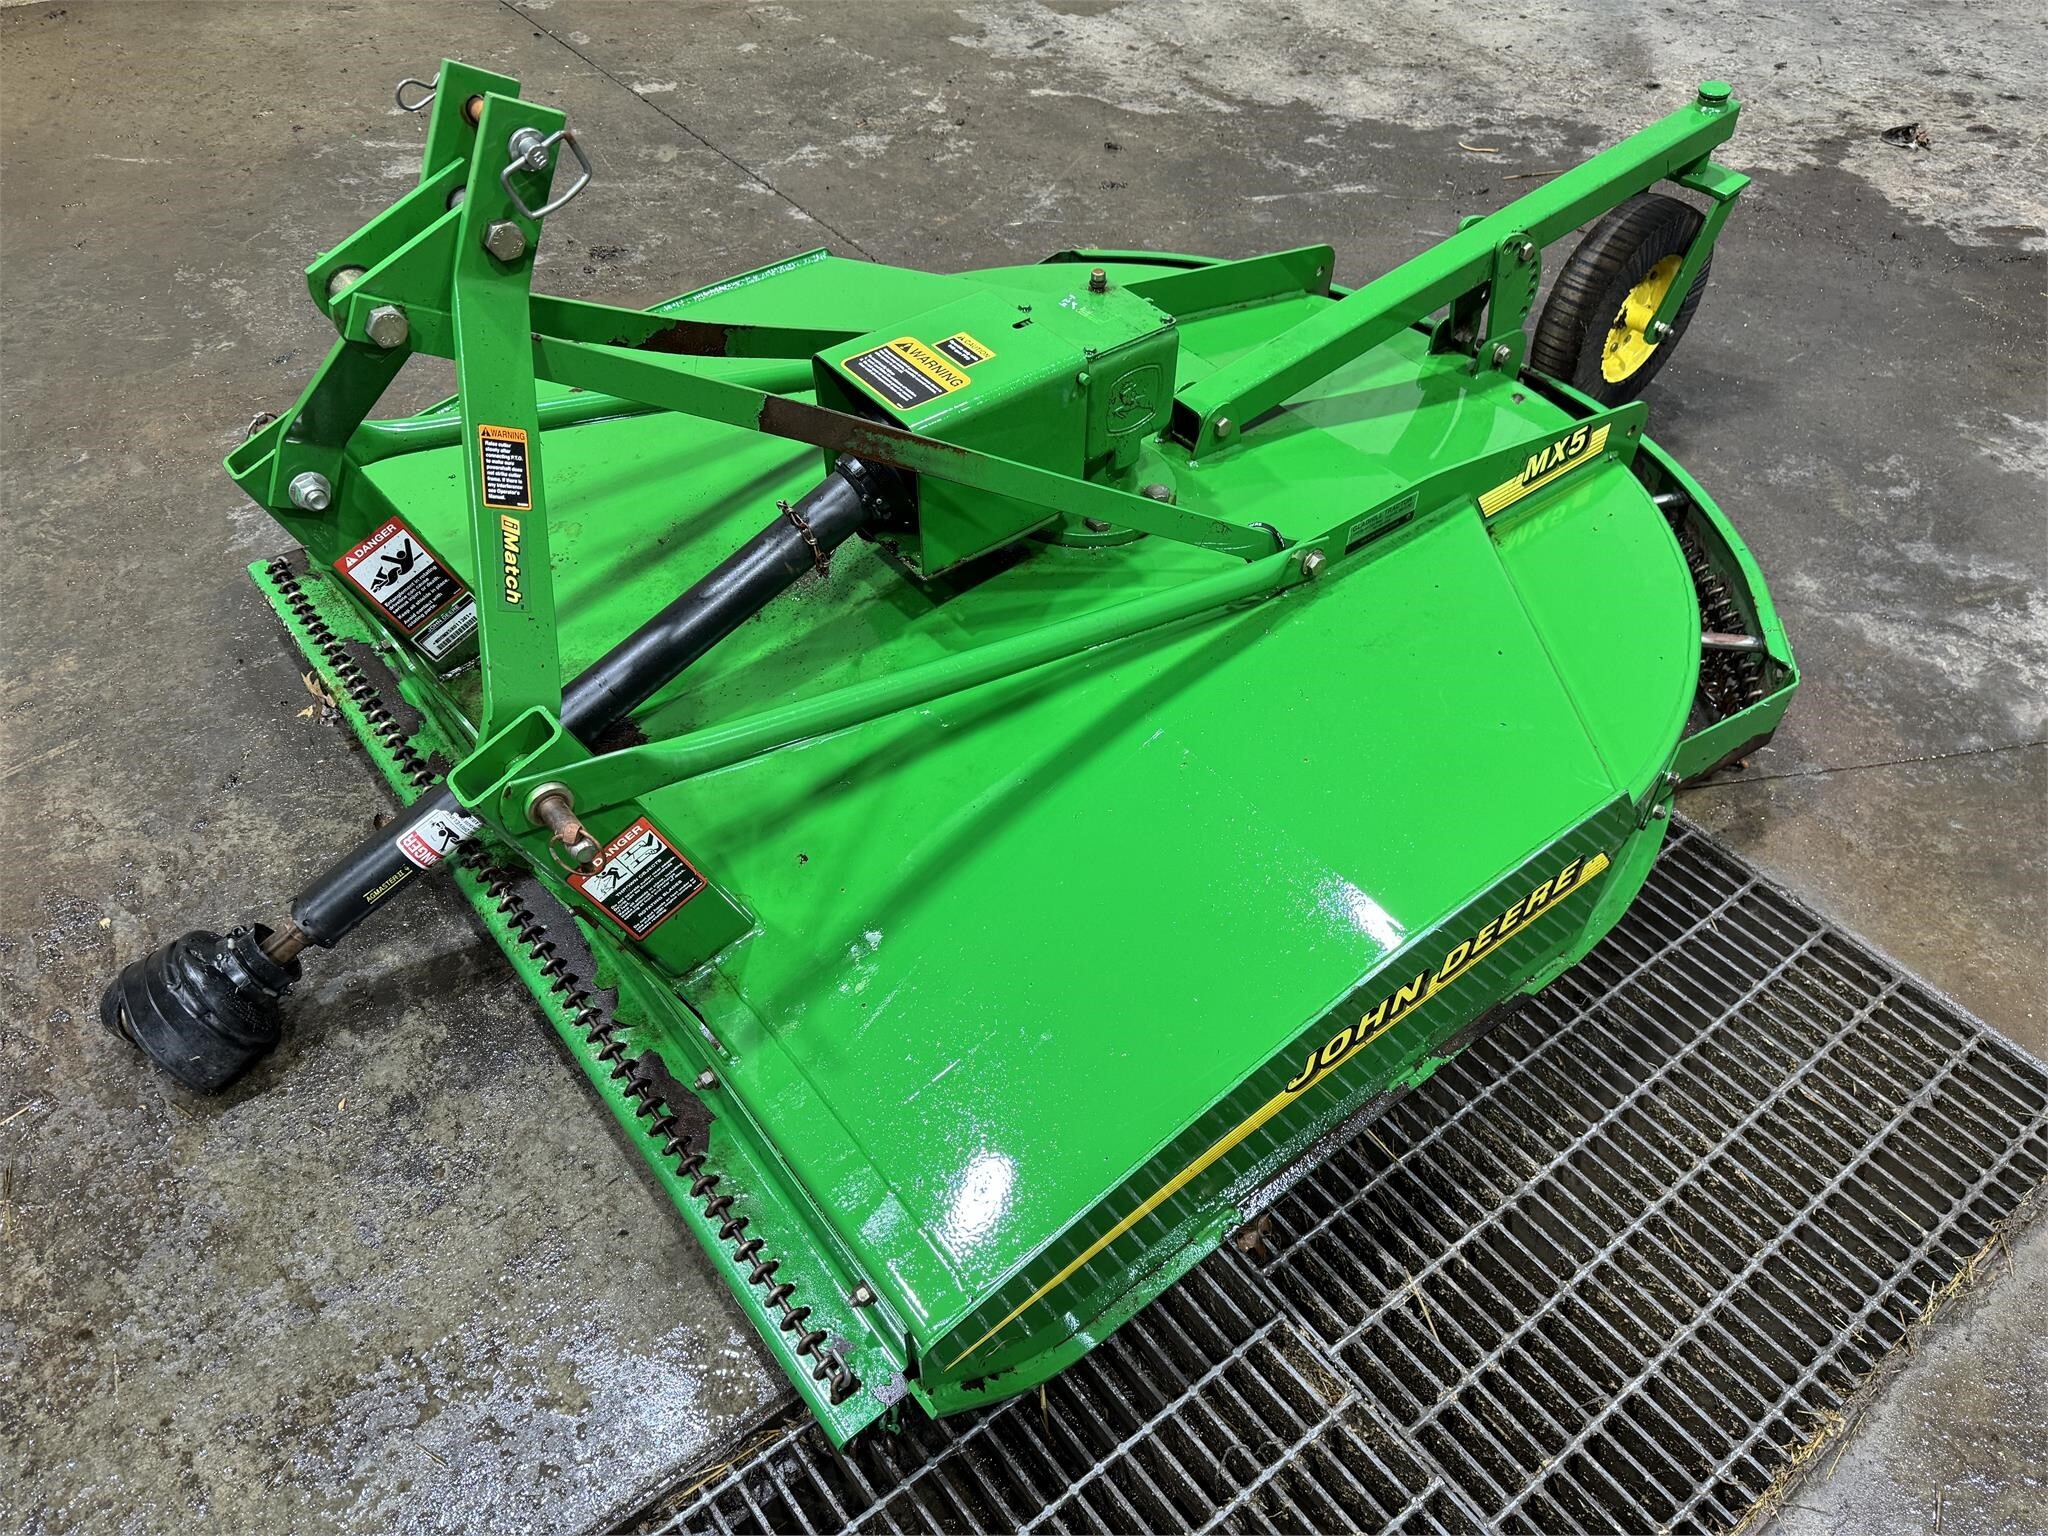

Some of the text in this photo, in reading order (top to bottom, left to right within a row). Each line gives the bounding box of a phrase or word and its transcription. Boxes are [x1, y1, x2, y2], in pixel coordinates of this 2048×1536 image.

[910, 347, 964, 388] WARNING
[964, 338, 992, 359] CAUTION
[490, 428, 526, 441] WARNING
[1522, 424, 1591, 484] MX5
[354, 523, 397, 559] DANGER
[502, 516, 522, 604] iMatch
[383, 581, 415, 607] Entanglement
[418, 564, 438, 580] rotating
[427, 604, 462, 633] JOHN DEERE
[402, 833, 439, 866] ANGER
[591, 825, 643, 867] DANGER
[364, 873, 399, 902] AGMASTER
[614, 857, 662, 898] THROWN OBJECTS
[637, 895, 663, 917] ROTATING
[661, 878, 683, 897] BLADES
[1288, 857, 1583, 1090] JOHN DEERE
